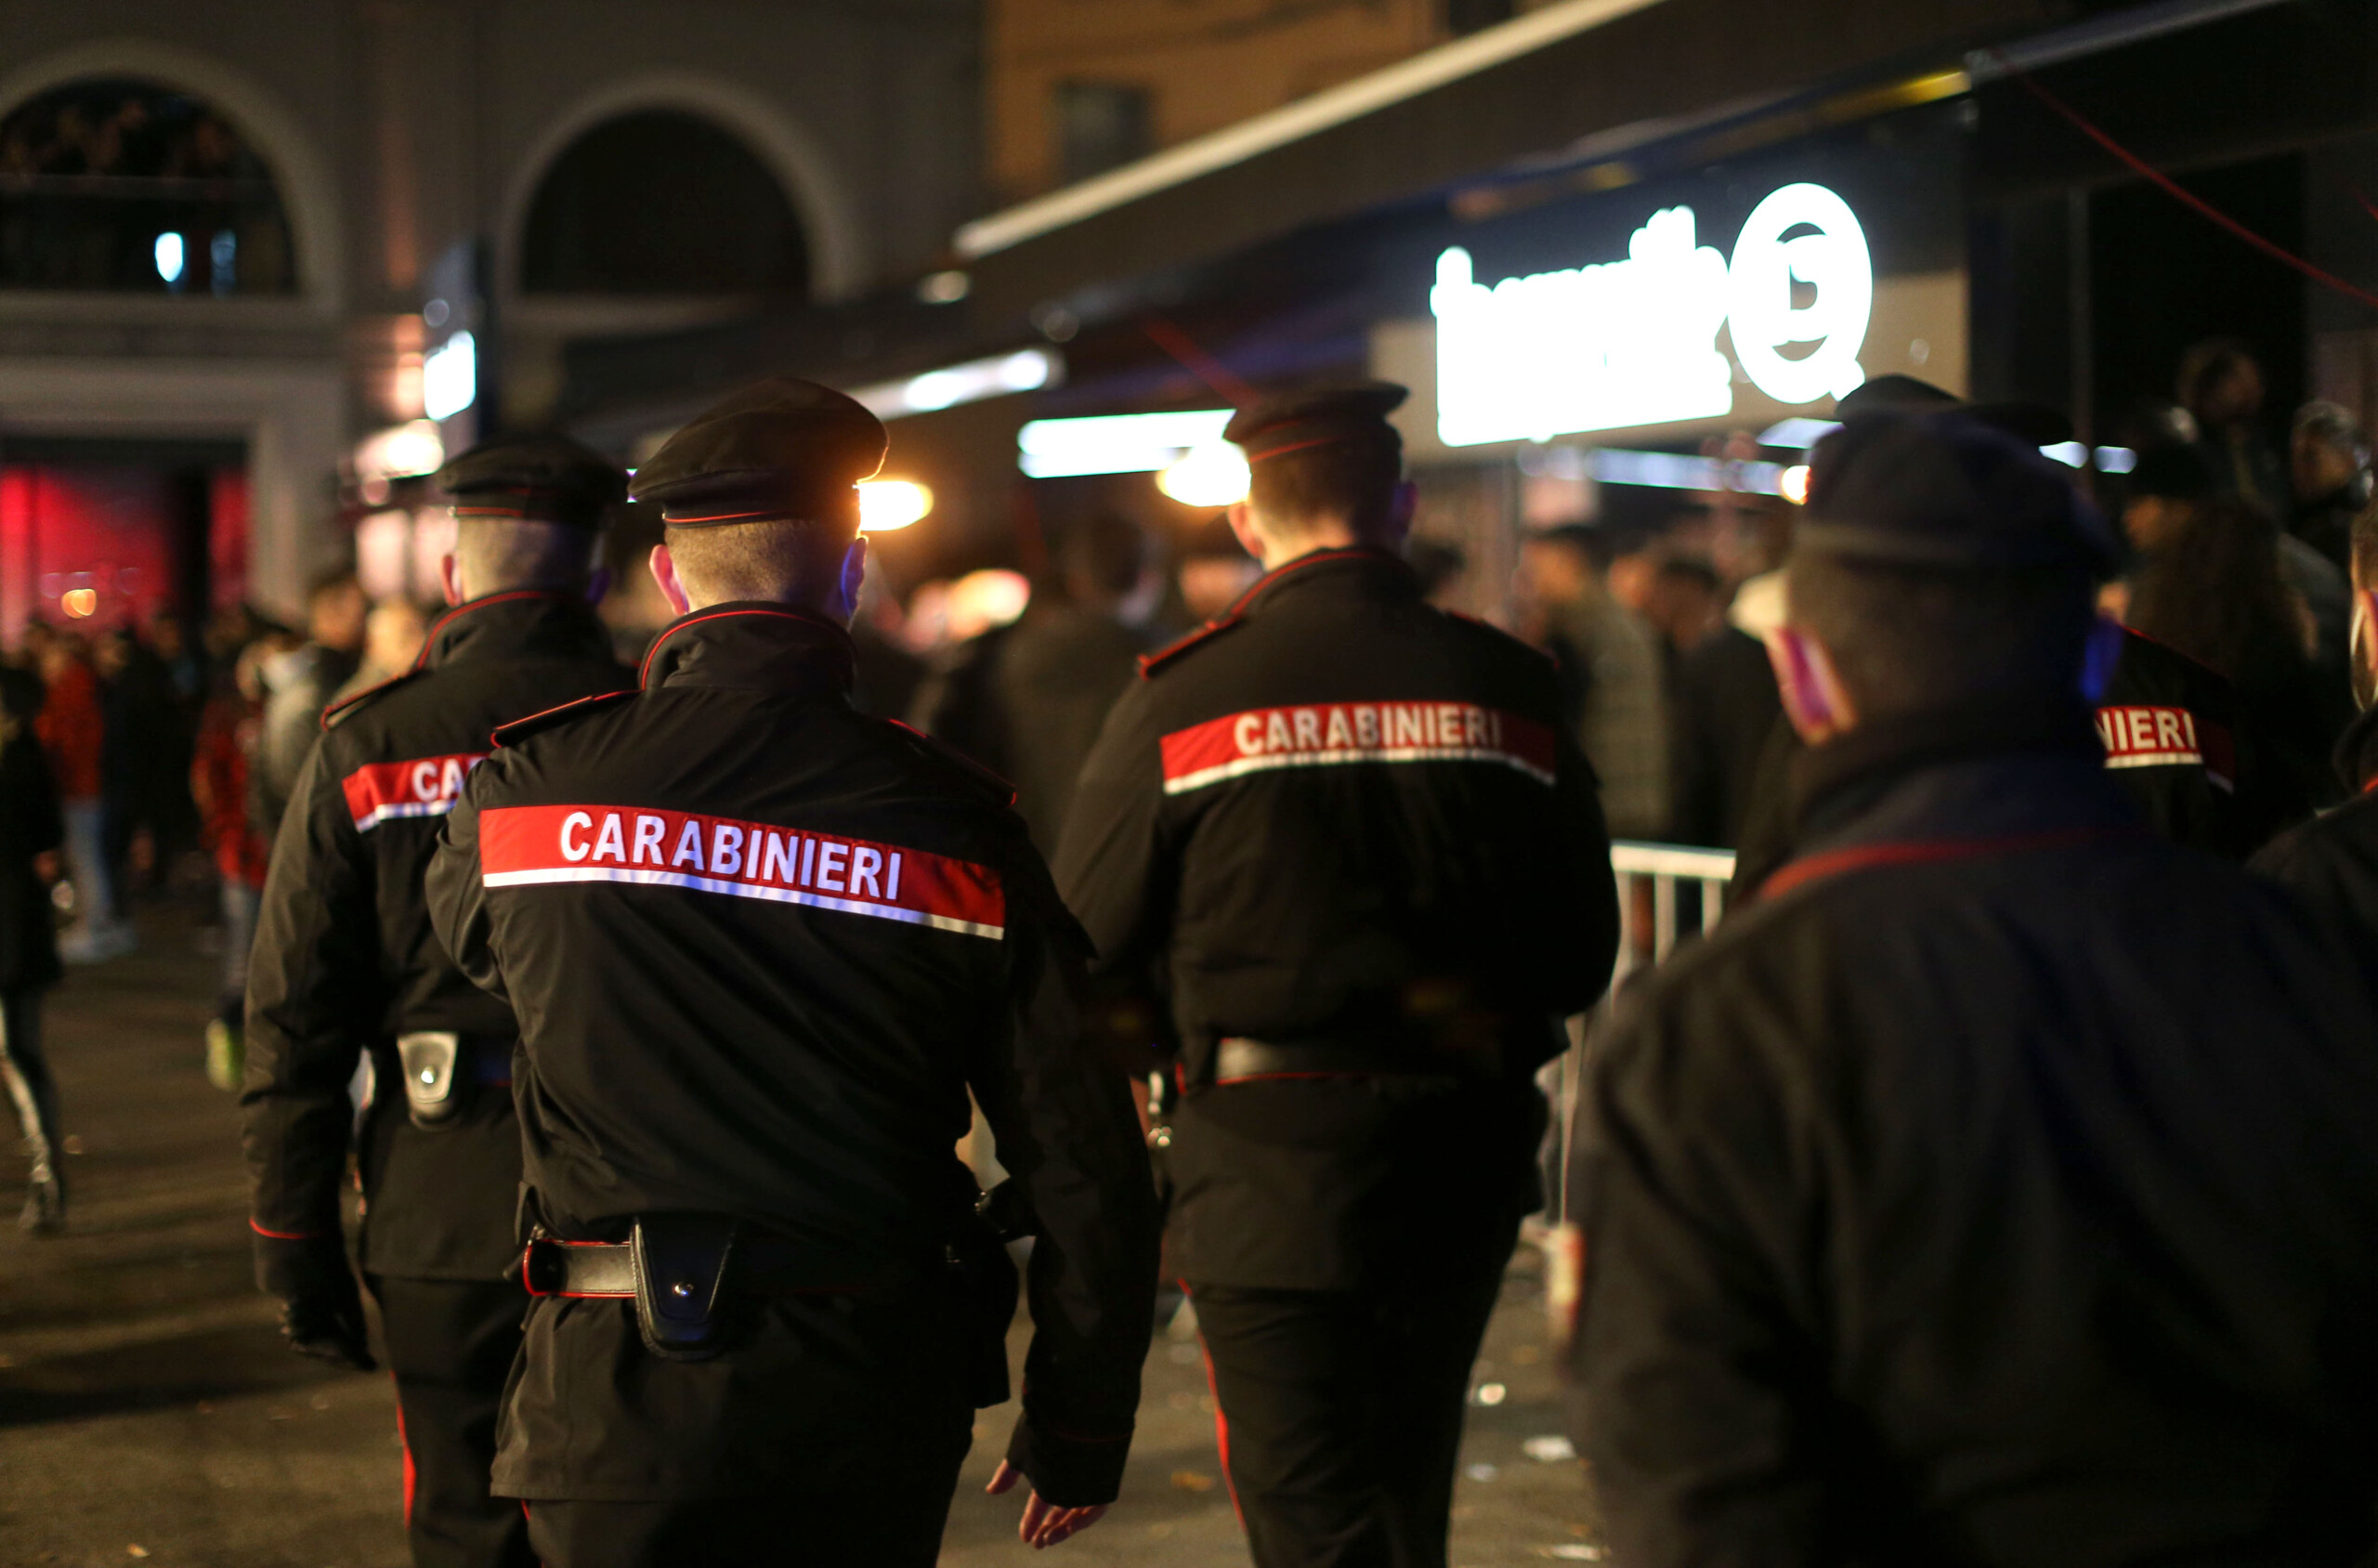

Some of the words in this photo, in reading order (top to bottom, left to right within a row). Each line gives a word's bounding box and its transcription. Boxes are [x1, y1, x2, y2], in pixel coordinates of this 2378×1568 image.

[1235, 704, 1501, 754] CARABINIERI
[412, 756, 485, 802] CA
[560, 811, 902, 900] CARABINIERI
